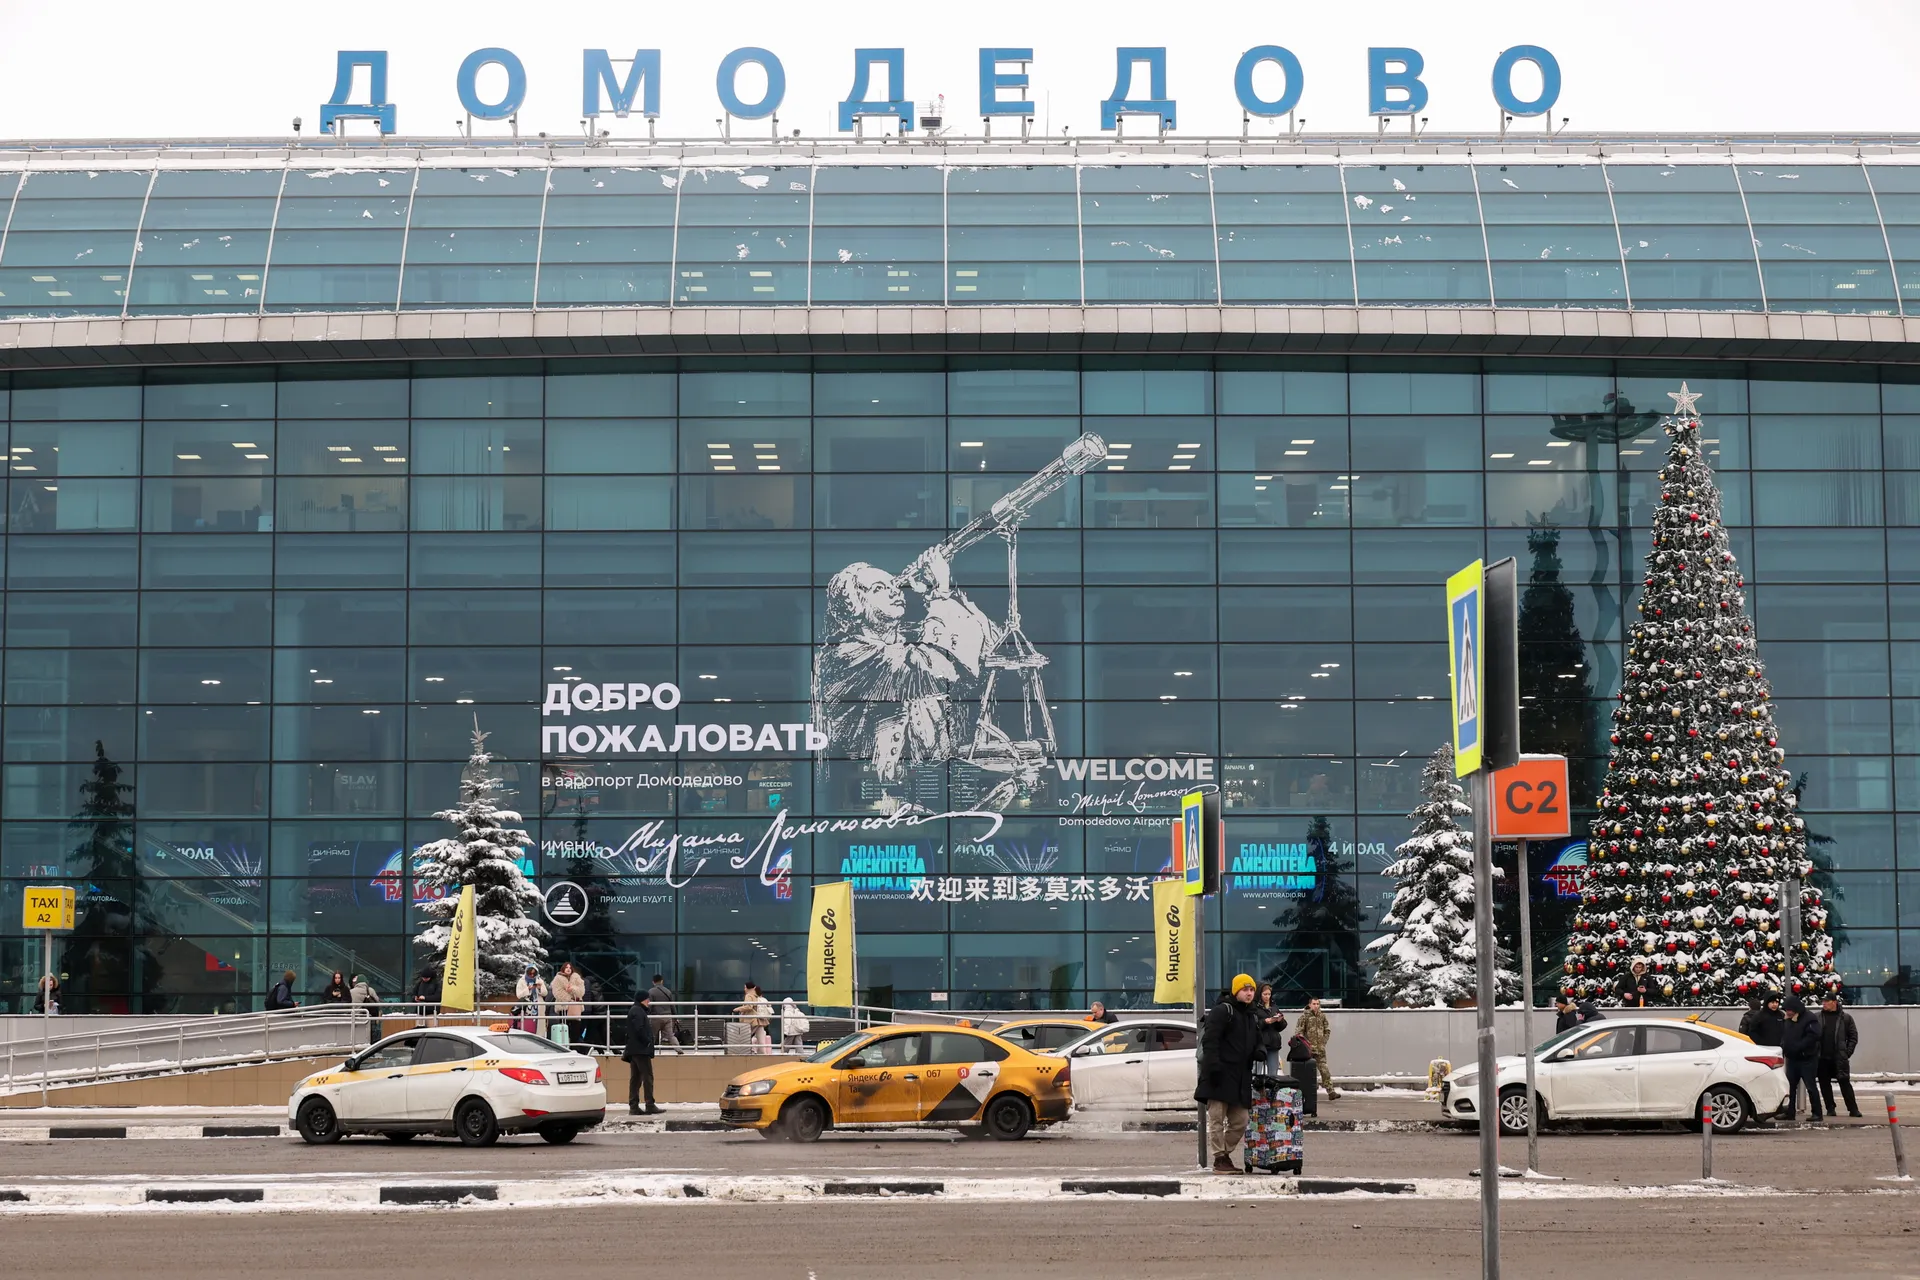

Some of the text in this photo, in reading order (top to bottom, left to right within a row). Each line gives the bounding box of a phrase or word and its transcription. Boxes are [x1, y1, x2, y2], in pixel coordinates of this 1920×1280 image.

[319, 44, 1562, 135] ДОМОДЕДОВО
[542, 682, 681, 715] ДОБРО
[541, 723, 829, 753] ПОЖАЛОВАТЬ
[1056, 758, 1214, 781] WELCOME
[542, 773, 743, 790] в аэропорт Домодедово
[1058, 797, 1070, 807] to
[1071, 781, 1130, 816] Mikhail
[1505, 780, 1559, 815] C2
[1058, 816, 1171, 828] Domodedovo Airport
[176, 847, 214, 860] ЮЛЯ
[541, 840, 596, 851] имени
[849, 845, 917, 860] БОЛЬШАЯ
[1240, 843, 1307, 858] БОЛЬШАЯ
[1327, 840, 1385, 855] 4 ИЮЛЯ
[840, 857, 927, 874] ДИСКОТЕКА
[1231, 856, 1317, 873] ДИСКОТЕКА
[909, 875, 1182, 902] 欢迎来到多莫杰多沃
[1233, 875, 1317, 890] АВТОРАДИО
[384, 884, 447, 901] РАИО
[600, 895, 641, 904] ПРИХОДИ!
[643, 895, 667, 904] БУДУТ
[31, 897, 59, 909] TAXI
[36, 913, 51, 923] A2
[448, 909, 464, 986] Яндекс Go
[821, 908, 837, 985] Яндекс Go
[1166, 905, 1181, 982] Яндекс Go
[848, 1071, 892, 1082] Яндекс Go
[926, 1069, 941, 1078] 067
